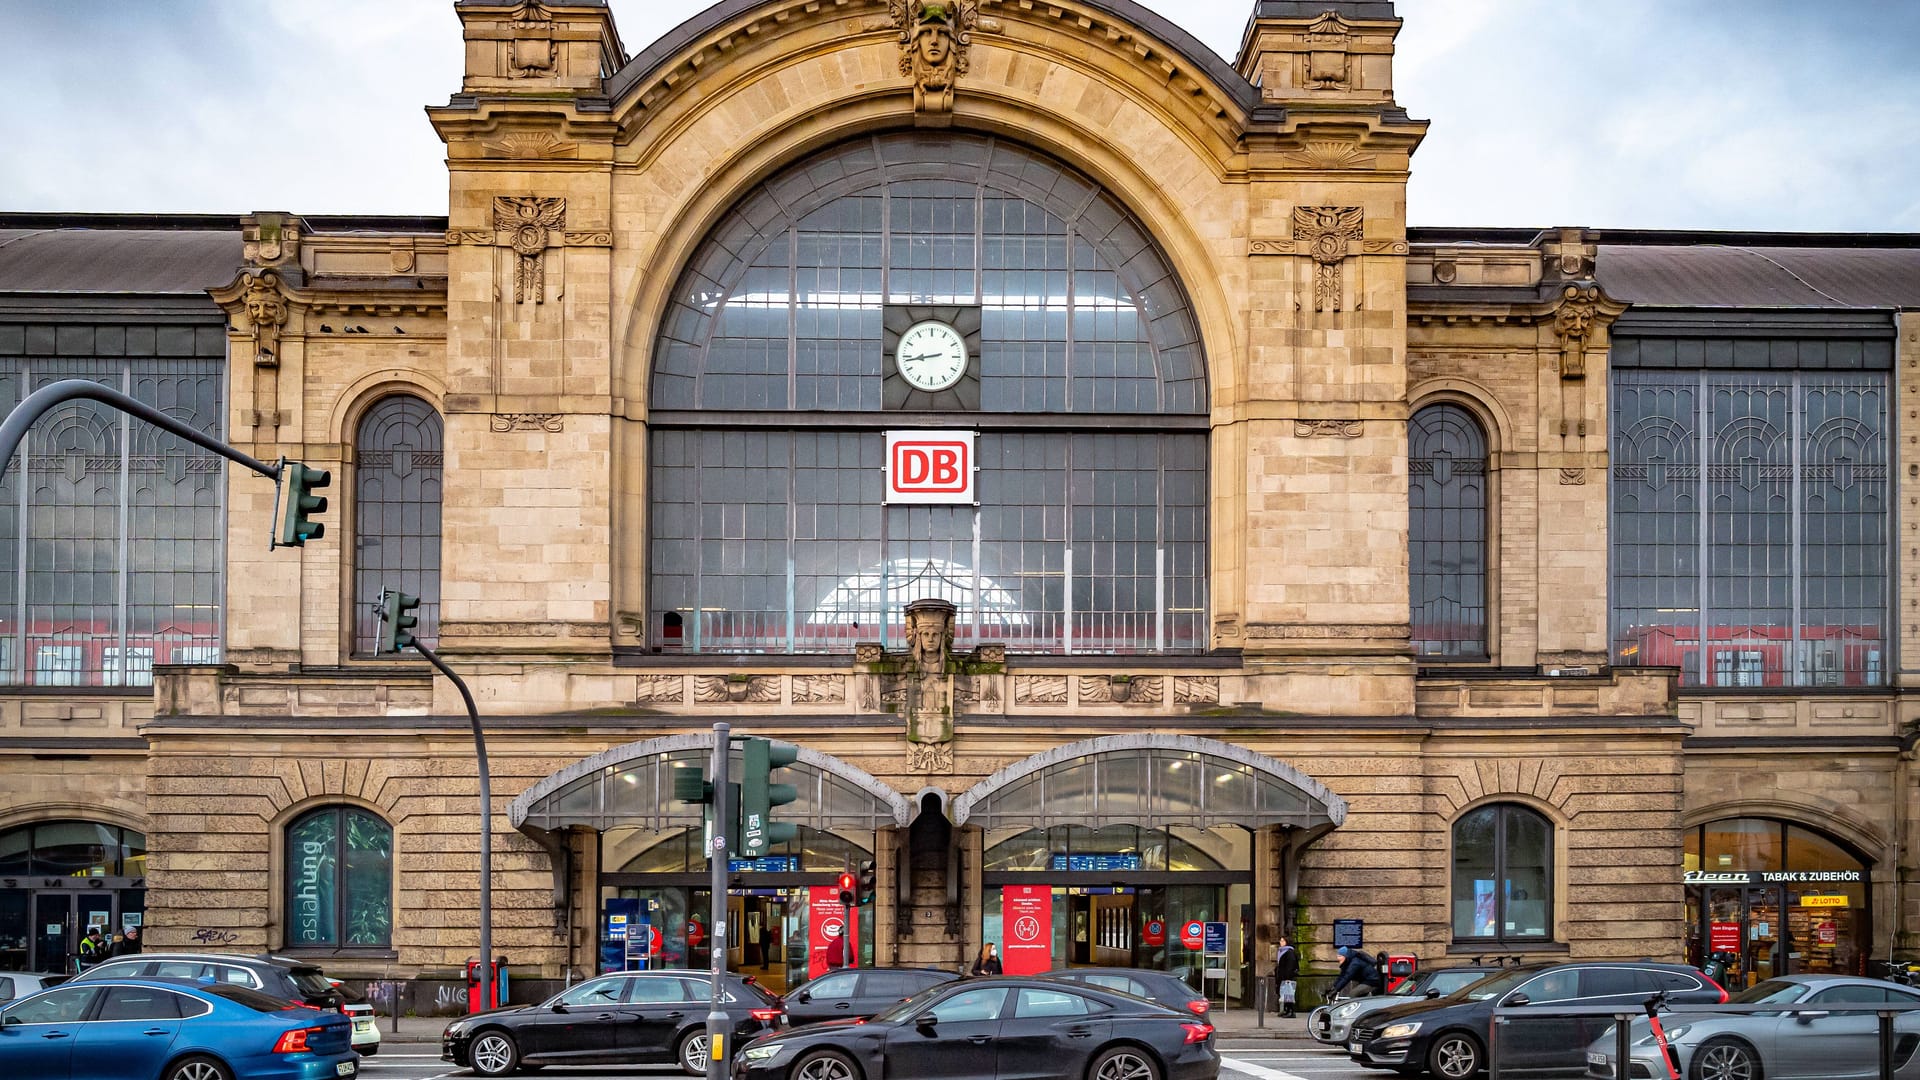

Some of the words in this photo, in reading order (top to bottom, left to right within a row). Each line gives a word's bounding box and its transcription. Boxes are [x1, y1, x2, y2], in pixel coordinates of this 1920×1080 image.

[902, 449, 958, 484] DB
[298, 842, 325, 941] asiahung
[1762, 872, 1797, 882] TABAK
[1799, 872, 1807, 881] &
[1809, 870, 1860, 881] ZUBEHÖR
